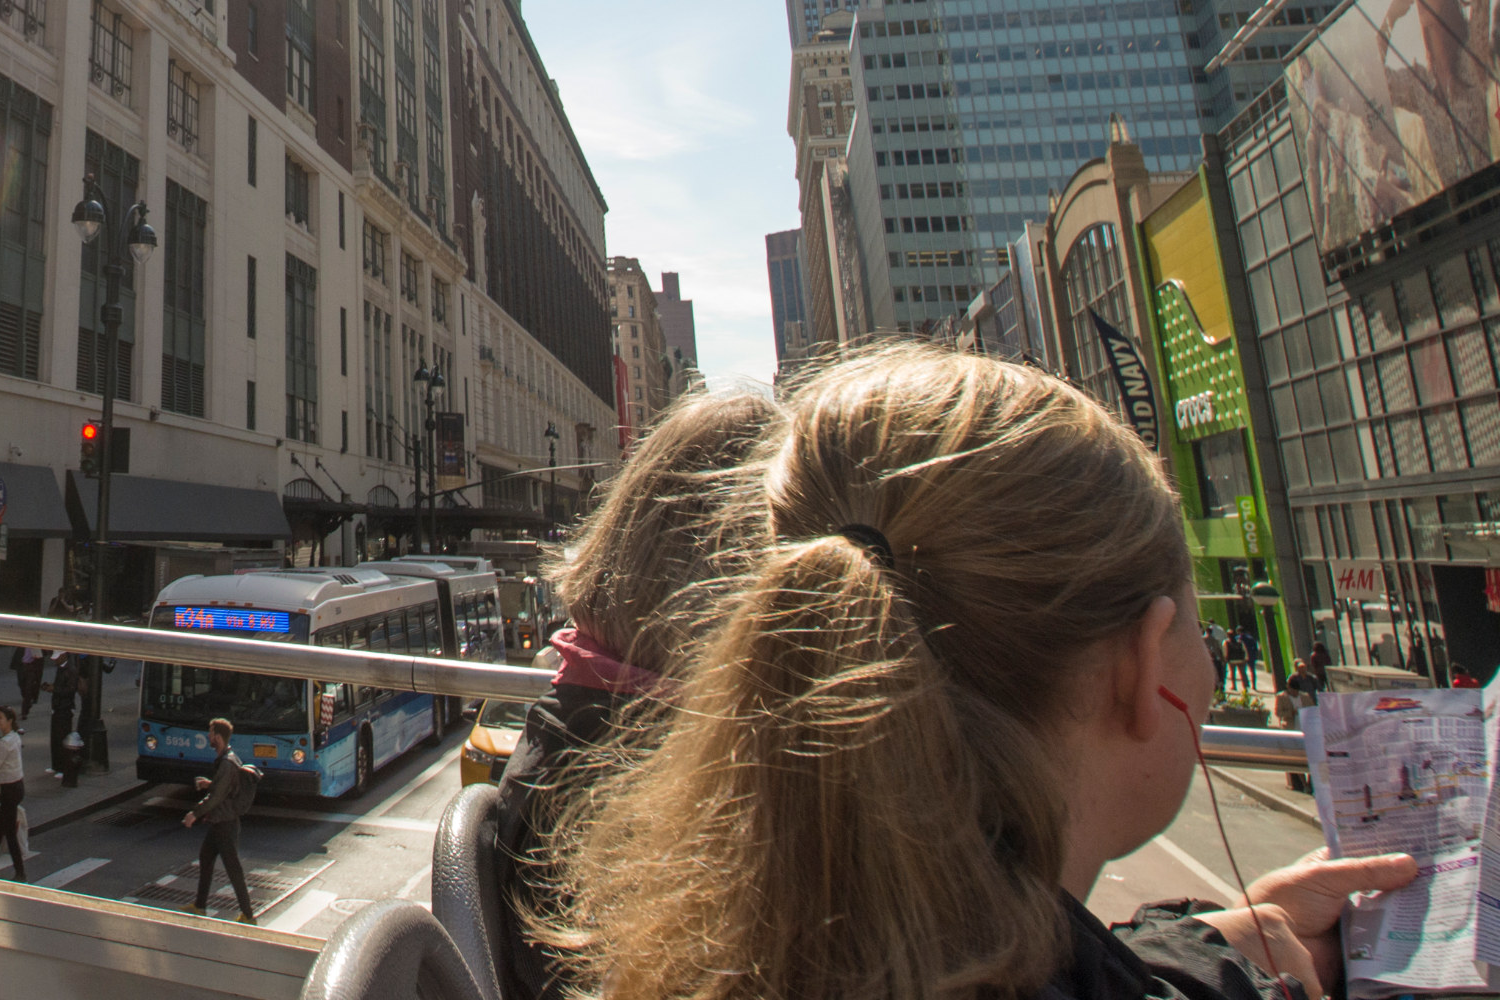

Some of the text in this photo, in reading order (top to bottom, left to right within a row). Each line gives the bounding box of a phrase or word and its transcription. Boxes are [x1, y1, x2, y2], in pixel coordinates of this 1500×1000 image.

[1108, 338, 1156, 448] OLD NAVY
[1175, 390, 1214, 430] crocs
[1239, 499, 1260, 555] crocs
[1337, 567, 1375, 592] H&M
[165, 735, 191, 748] 5934
